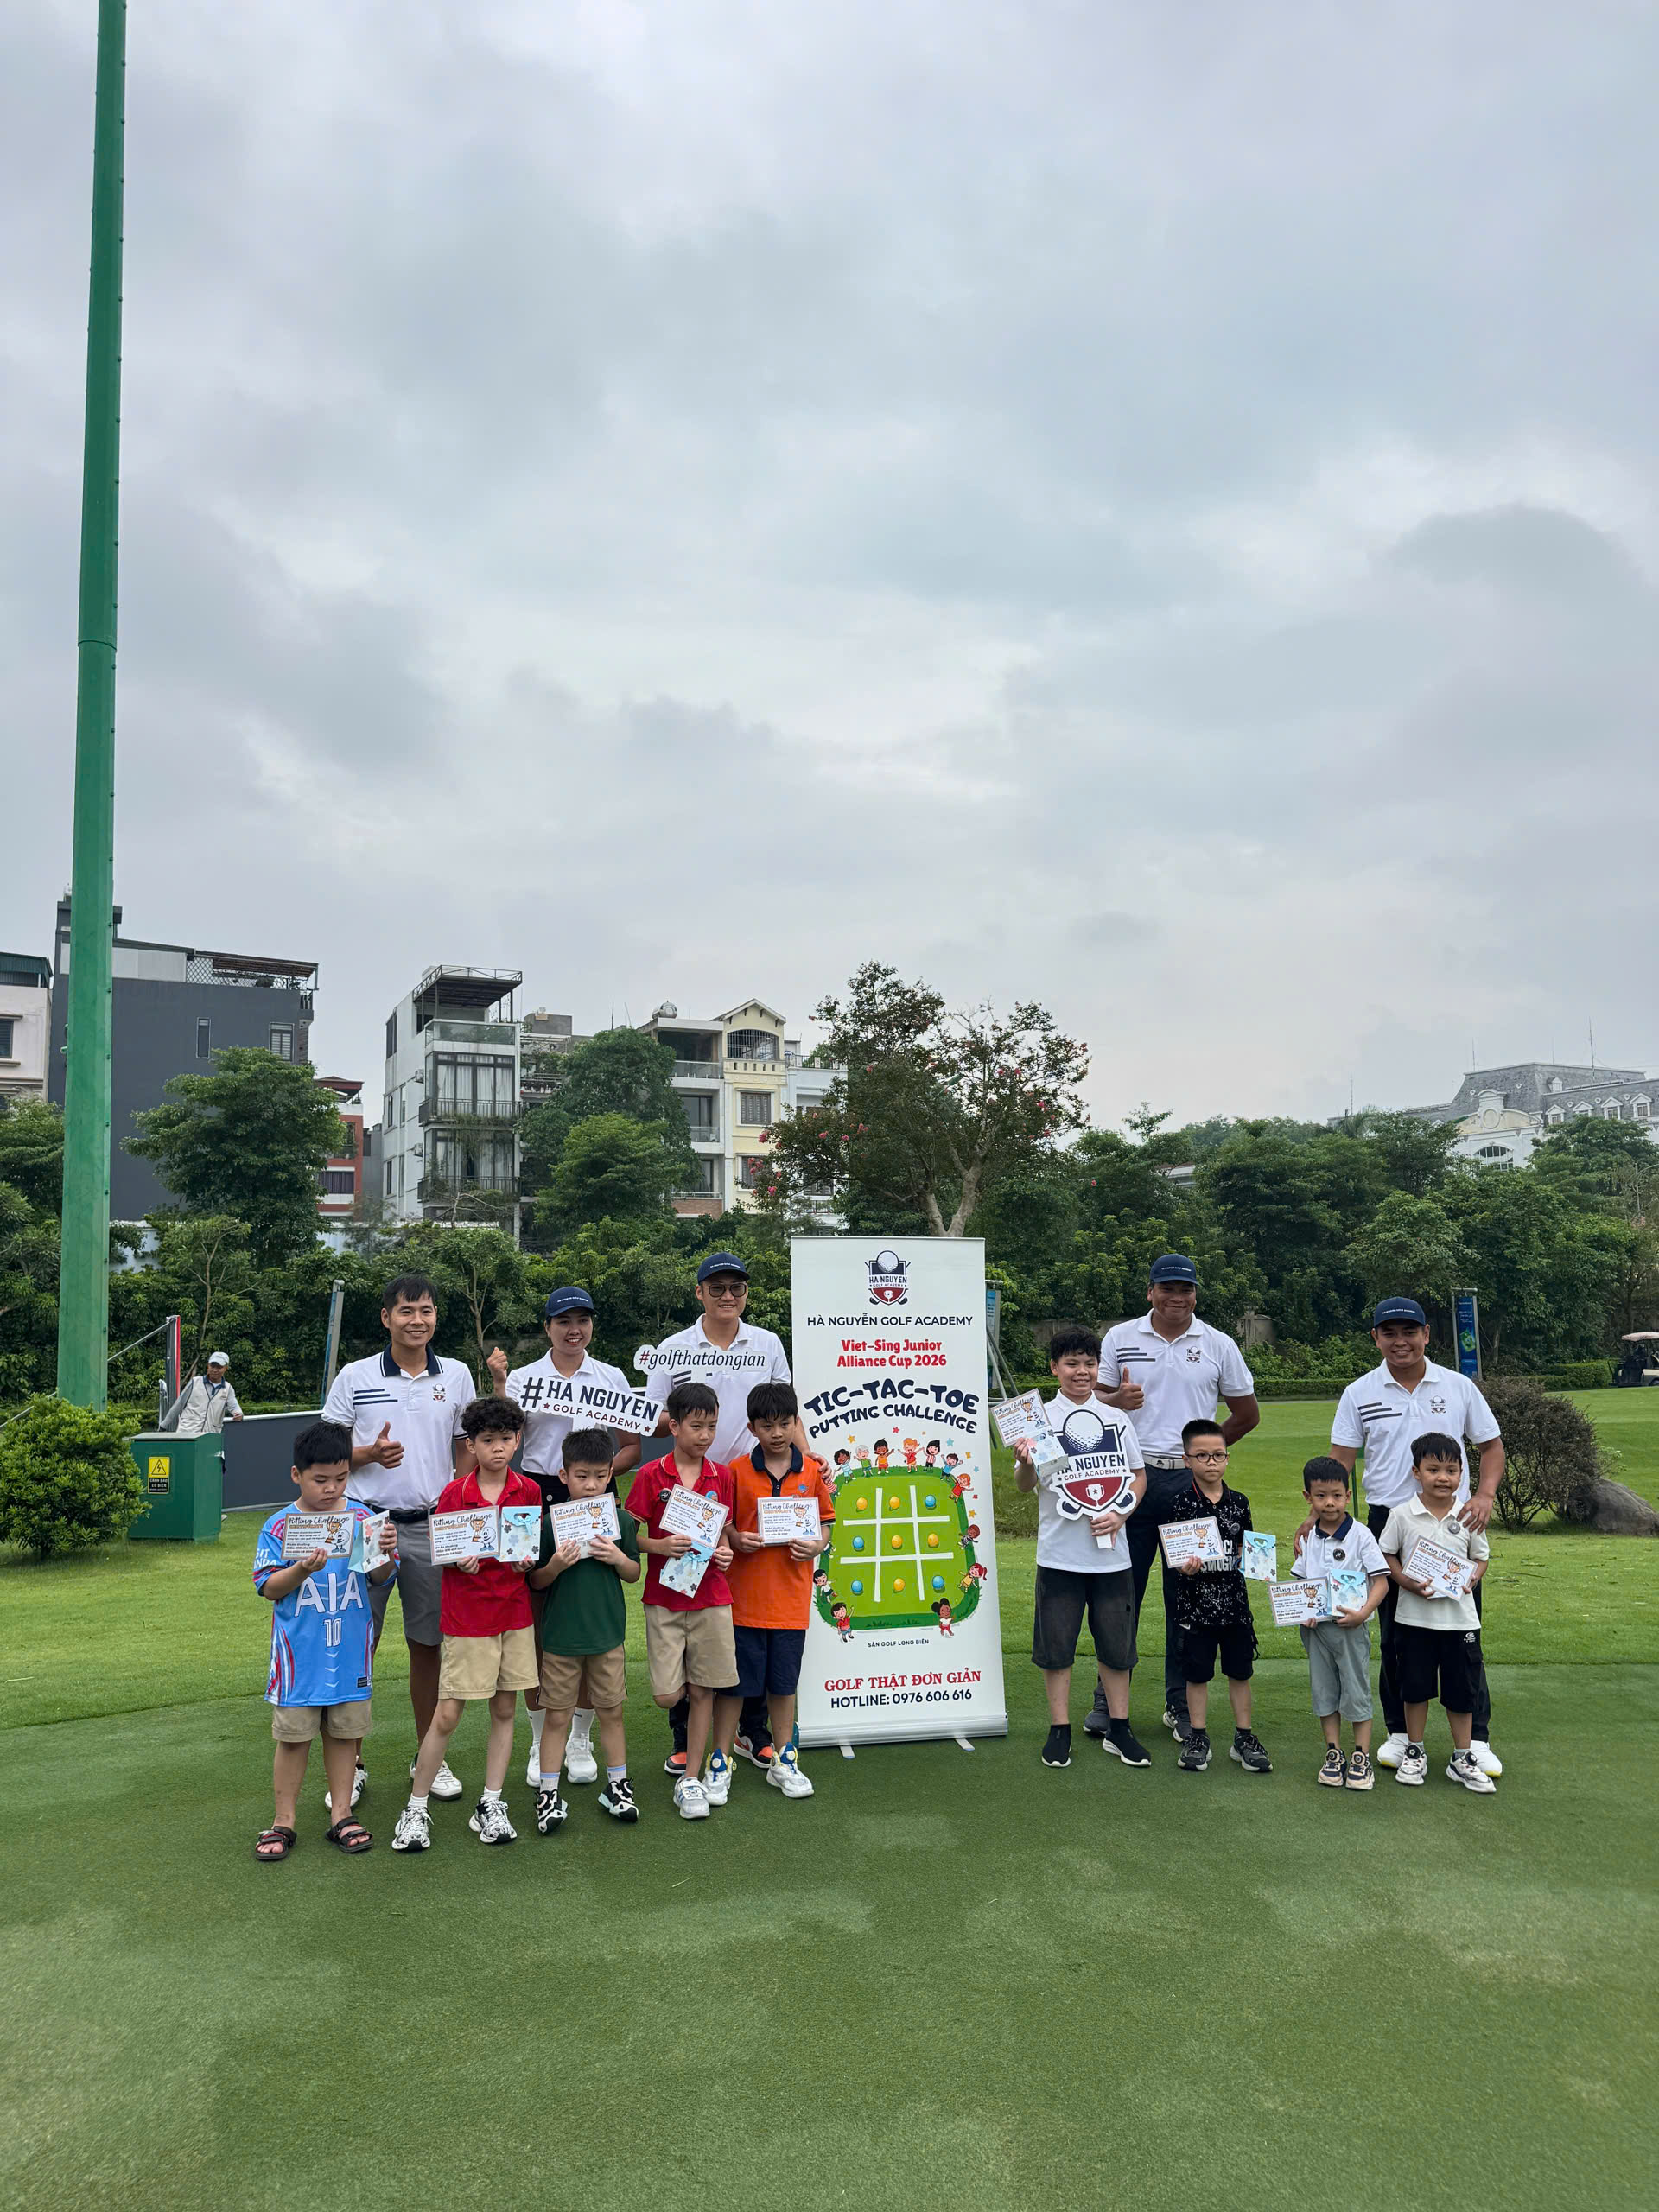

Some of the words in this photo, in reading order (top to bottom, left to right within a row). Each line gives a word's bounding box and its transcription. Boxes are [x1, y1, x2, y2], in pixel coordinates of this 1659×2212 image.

[807, 1315, 825, 1326] HÀ
[828, 1313, 878, 1325] NGUYỄN
[880, 1316, 912, 1325] GOLF
[914, 1316, 973, 1325] ACADEMY
[903, 1339, 942, 1351] Junior
[639, 1350, 766, 1370] #golfthatdongian
[837, 1355, 887, 1367] Alliance
[888, 1355, 912, 1369] Cup
[914, 1354, 947, 1366] 2026
[579, 1385, 658, 1421] NGUYEN
[804, 1378, 980, 1416] TIC-TAC-TOE
[552, 1403, 582, 1415] GOLF
[585, 1410, 641, 1430] ACADEMY
[809, 1406, 880, 1439] PUTTING
[883, 1403, 977, 1434] CHALLENGE
[1075, 1453, 1126, 1471] NGUYEN
[1085, 1469, 1120, 1478] ACADEMY
[294, 1571, 364, 1618] AIA
[324, 1618, 342, 1648] 10
[824, 1678, 864, 1692] GOLF
[868, 1673, 907, 1691] THẬT
[912, 1671, 943, 1686] ĐƠN
[946, 1667, 982, 1683] GIẢN
[830, 1694, 890, 1708] HOTLINE:
[893, 1692, 923, 1705] 0976
[926, 1691, 950, 1702] 606
[952, 1688, 972, 1700] 616
